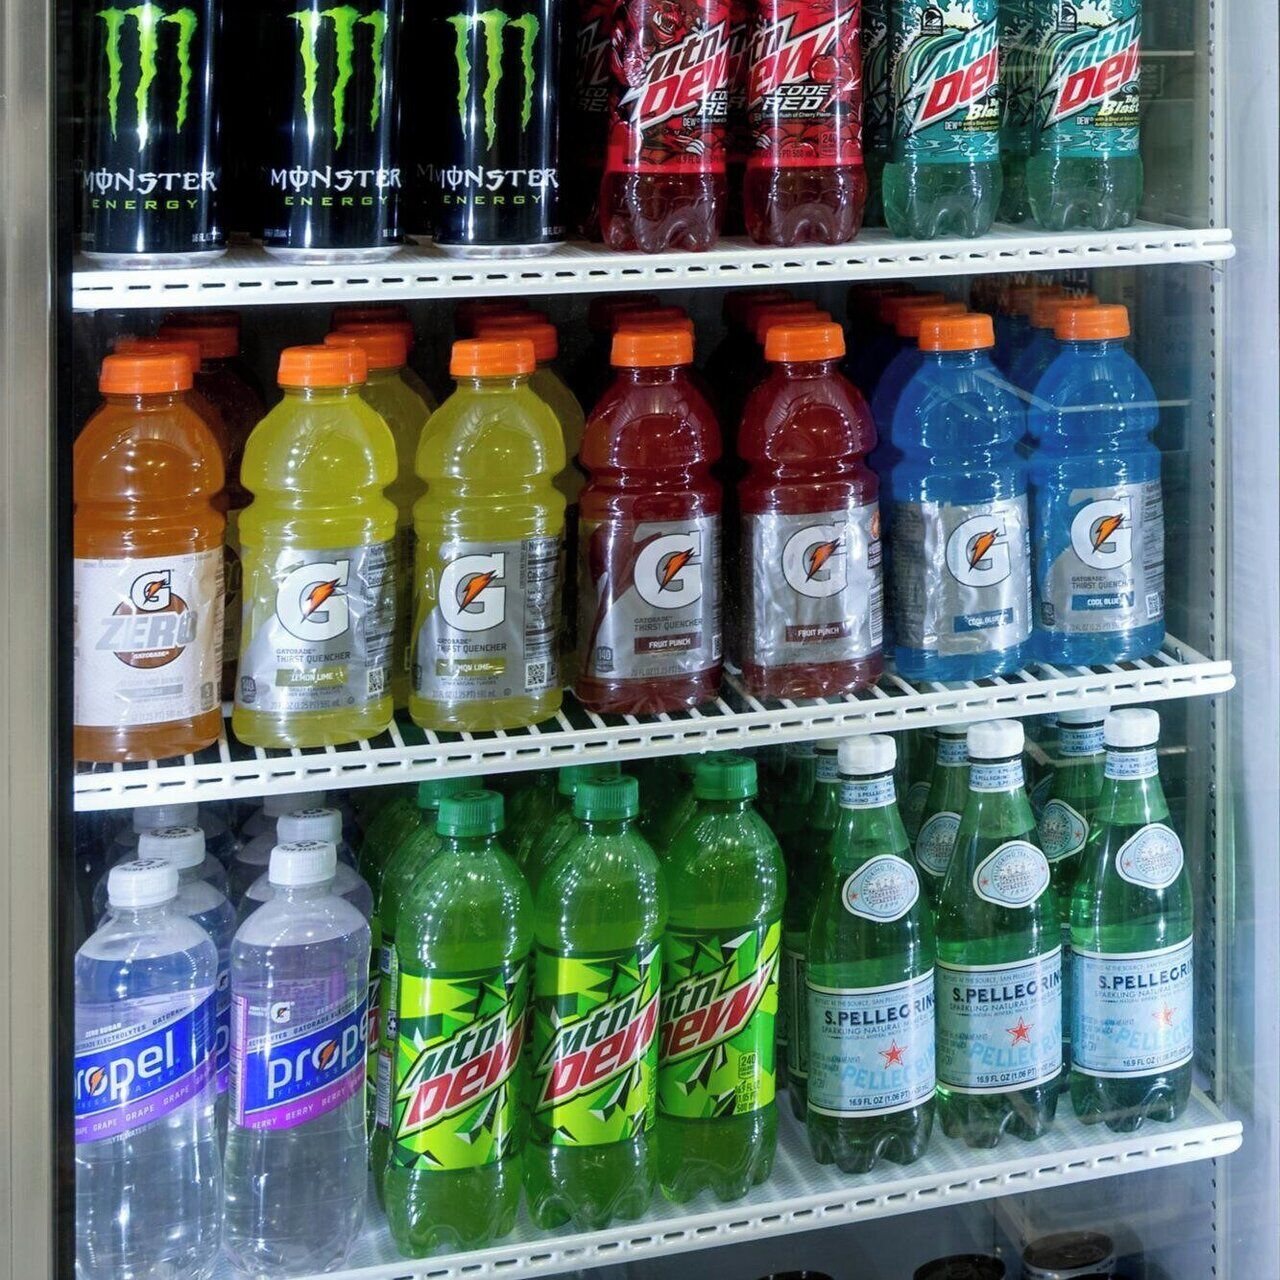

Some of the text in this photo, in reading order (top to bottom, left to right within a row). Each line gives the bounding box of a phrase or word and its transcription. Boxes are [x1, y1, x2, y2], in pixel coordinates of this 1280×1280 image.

[778, 86, 832, 95] CODE
[763, 97, 823, 111] RED
[83, 167, 218, 192] MONSTER
[271, 166, 401, 190] MONSTER
[437, 166, 559, 189] MONSTER
[92, 198, 198, 209] ENERGY
[285, 196, 387, 206] ENERGY
[443, 195, 542, 204] ENERGY
[439, 552, 505, 632] G
[276, 560, 350, 641] G
[95, 611, 197, 650] ZERO
[634, 623, 662, 631] THIRST
[464, 643, 507, 651] QUENCHER
[649, 639, 691, 649] FRUIT PUNCH
[277, 652, 350, 663] THIRST QUENCHER
[93, 1086, 190, 1132] GRAPE GRAPE GRAPE
[286, 1089, 346, 1119] BERRY BERRY
